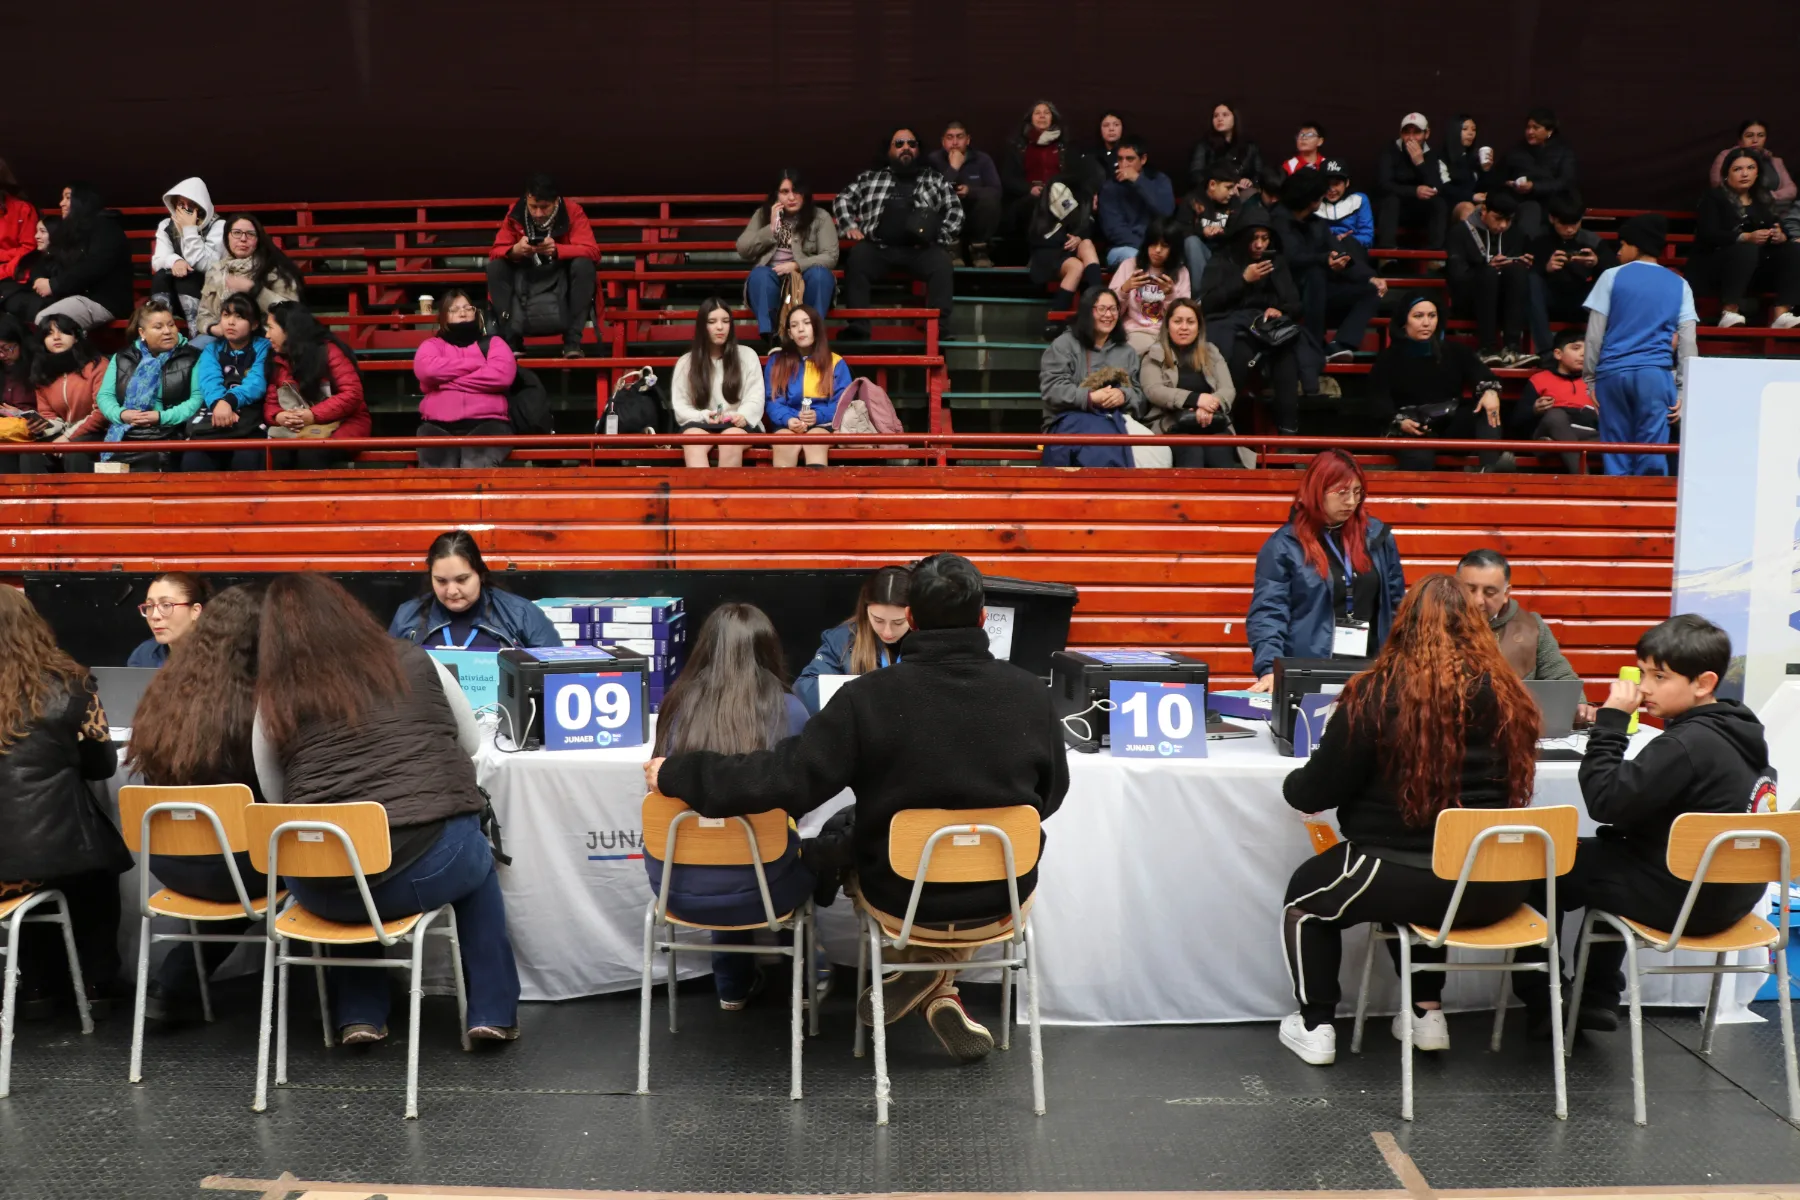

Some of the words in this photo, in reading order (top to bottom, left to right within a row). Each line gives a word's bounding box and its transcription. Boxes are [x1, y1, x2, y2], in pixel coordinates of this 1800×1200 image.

[555, 682, 631, 730] 09
[1121, 691, 1194, 740] 10
[564, 735, 594, 744] JUNAEB
[1125, 743, 1156, 752] JUNAEB
